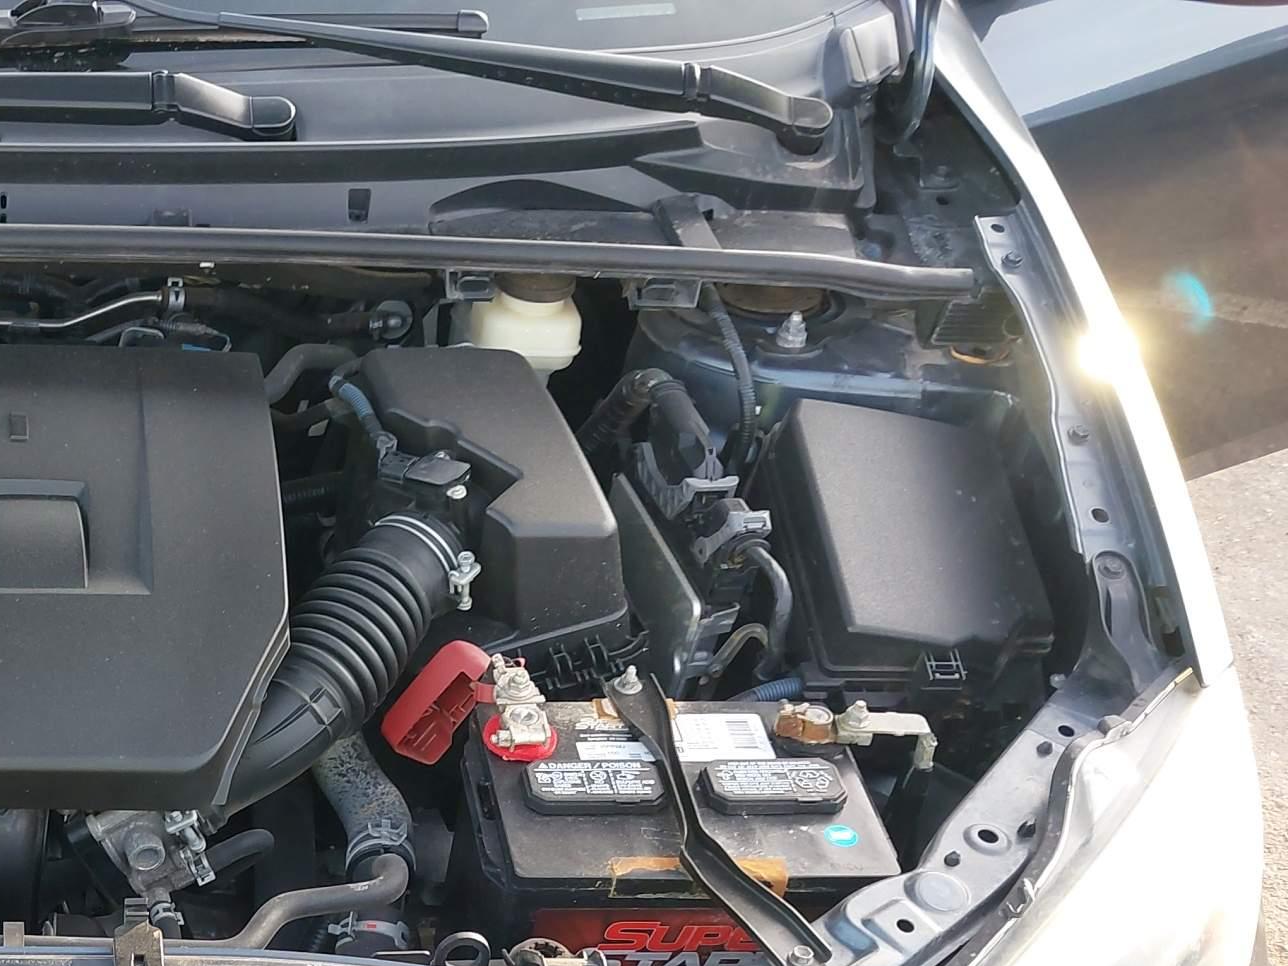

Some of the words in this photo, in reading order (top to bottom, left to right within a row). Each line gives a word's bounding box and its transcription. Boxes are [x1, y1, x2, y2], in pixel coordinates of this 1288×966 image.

[547, 762, 592, 770] DANGER
[601, 762, 642, 770] POISON
[597, 921, 761, 952] SUPE
